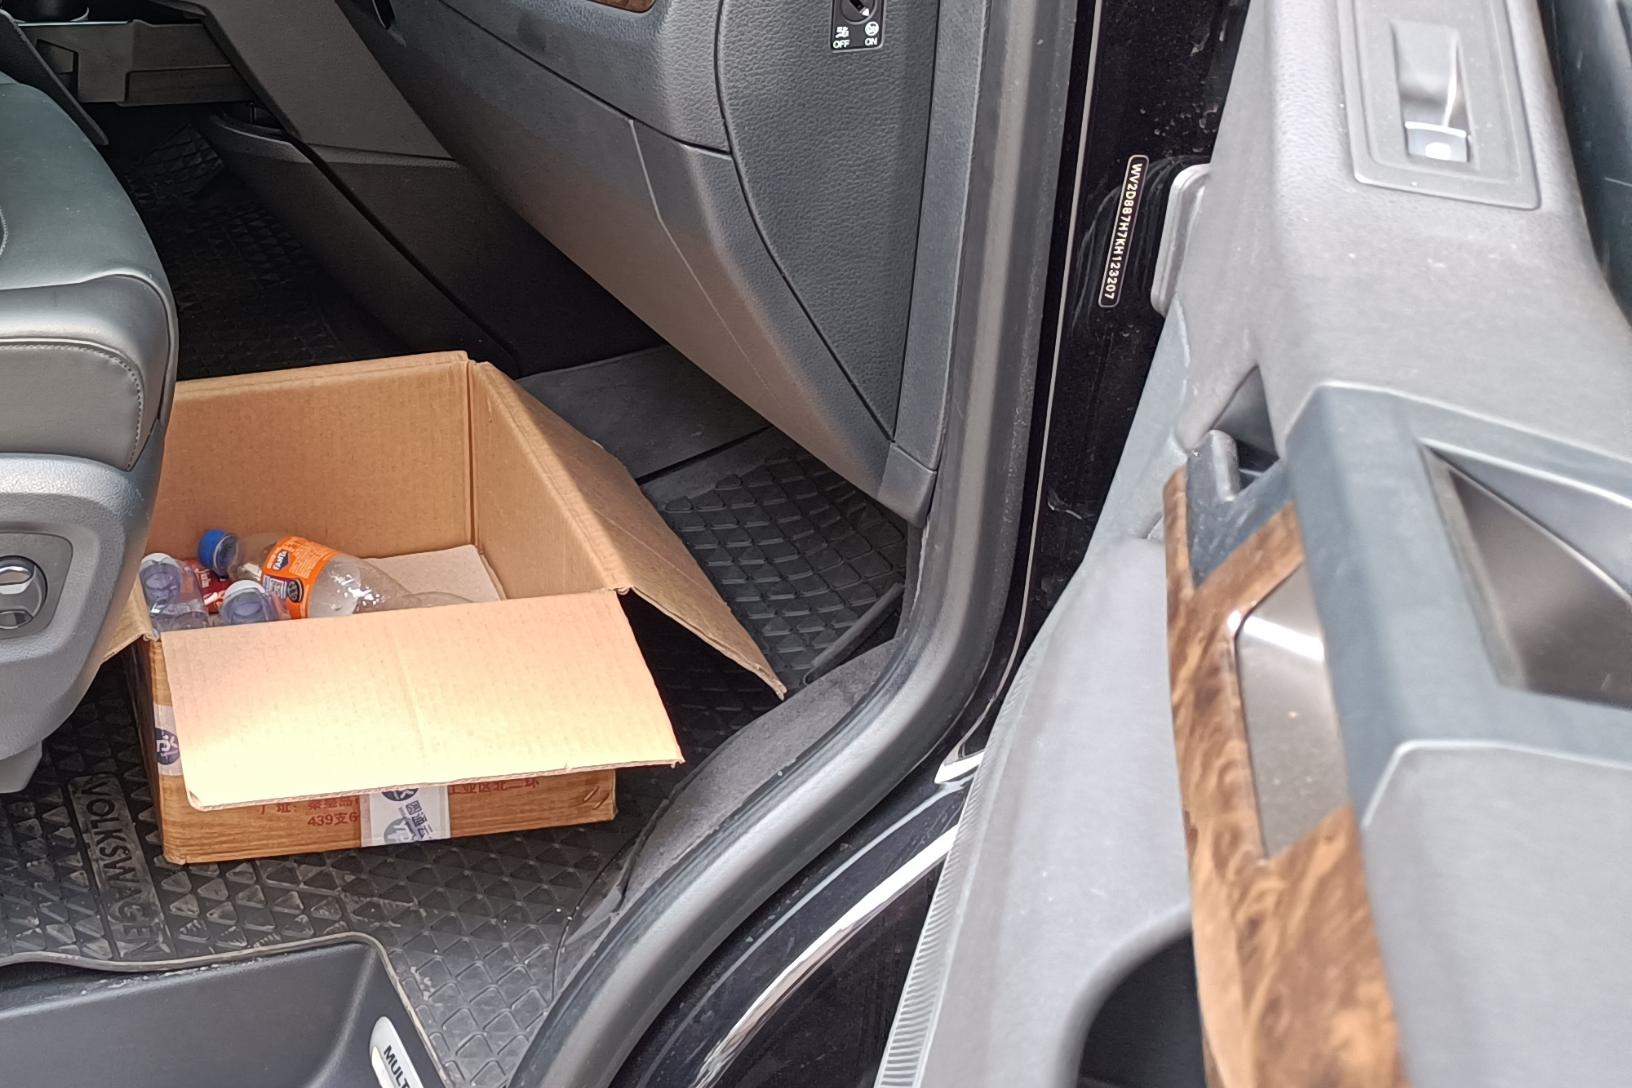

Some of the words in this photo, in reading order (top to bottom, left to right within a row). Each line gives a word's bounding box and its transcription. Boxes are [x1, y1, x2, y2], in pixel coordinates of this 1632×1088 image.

[833, 39, 850, 48] OFF
[865, 38, 878, 46] ON
[82, 782, 168, 952] VOLKSWAGEN
